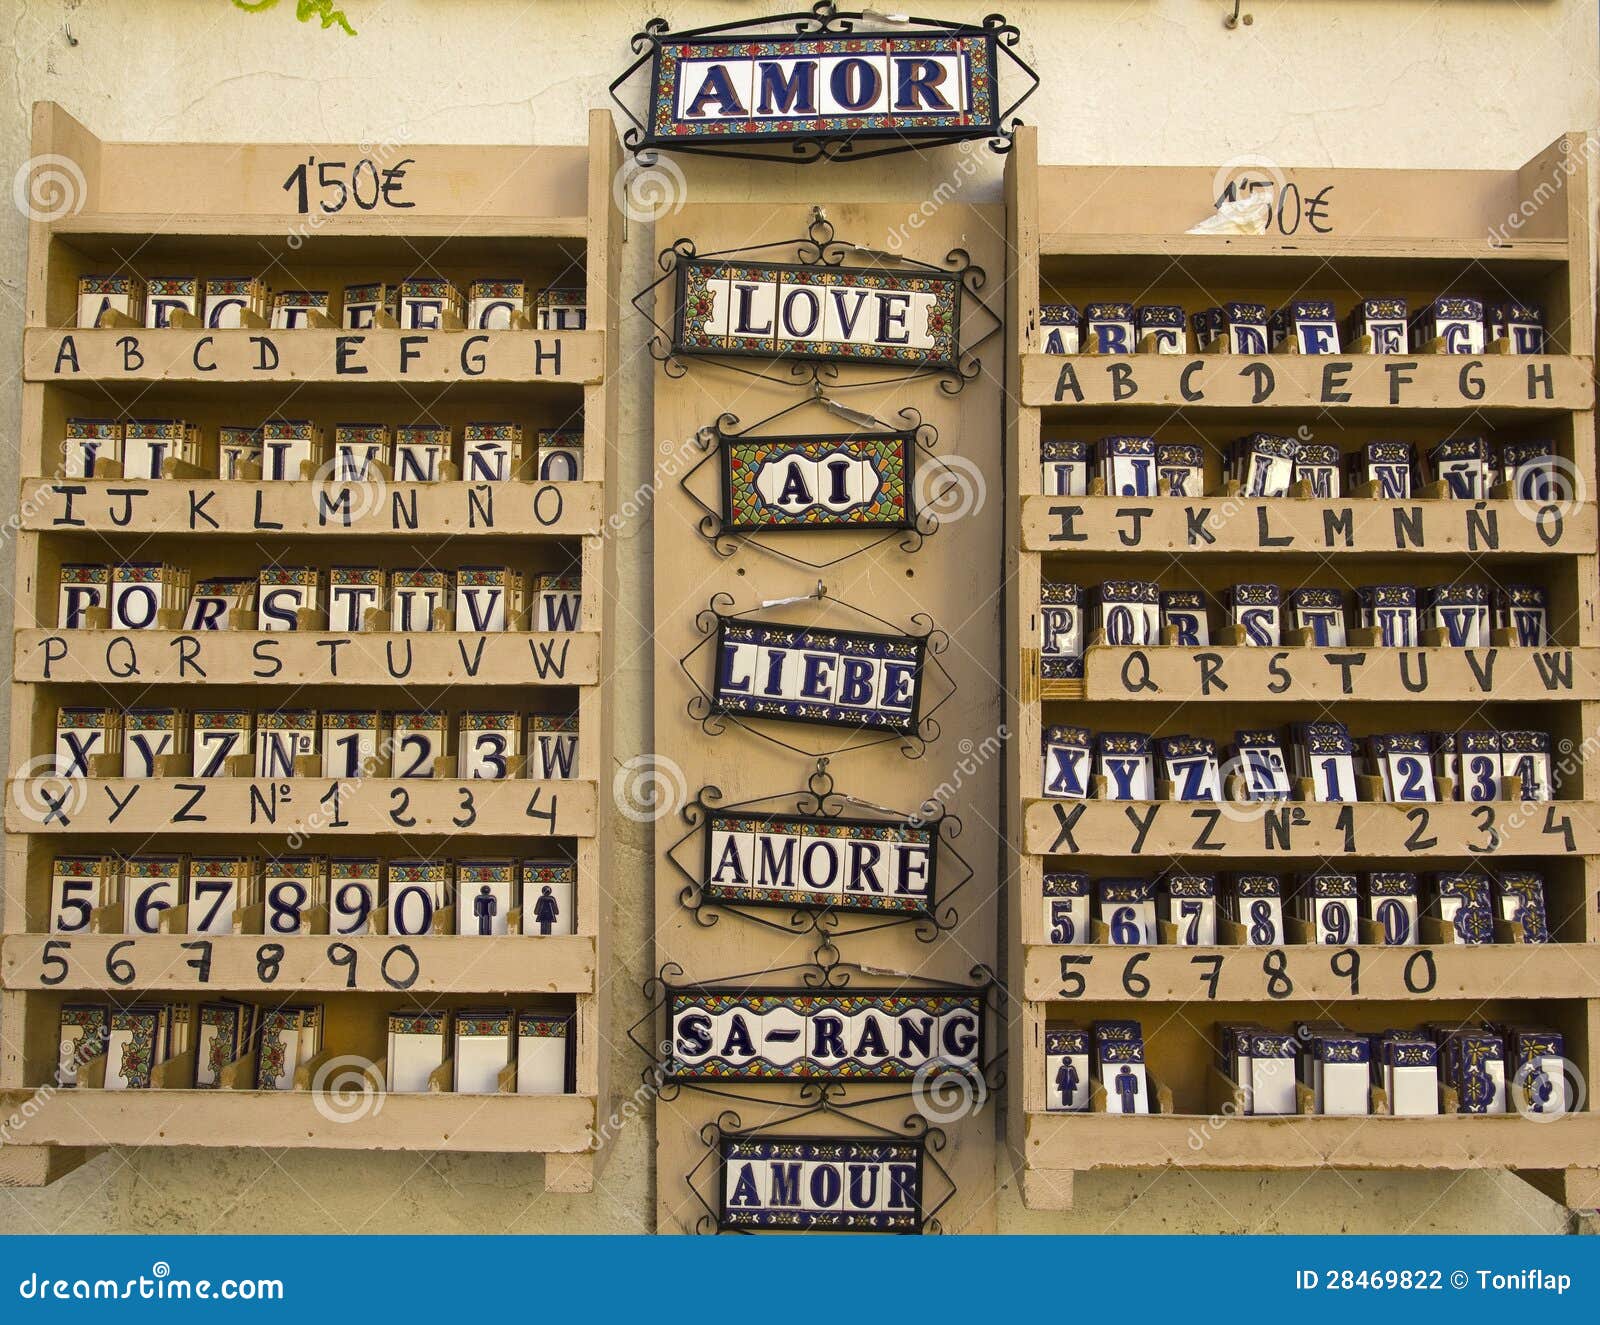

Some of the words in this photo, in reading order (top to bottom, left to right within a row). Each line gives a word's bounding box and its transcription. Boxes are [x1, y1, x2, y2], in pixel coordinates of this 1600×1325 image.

[686, 57, 956, 118] AMOR
[283, 156, 415, 213] 1'50€
[735, 283, 911, 344] LOVE
[55, 336, 79, 373] A
[116, 336, 144, 370] B
[194, 337, 216, 371] C
[250, 337, 278, 369] D
[336, 337, 368, 374] E
[400, 336, 428, 373] F
[461, 336, 489, 375] G
[535, 339, 560, 375] H
[1055, 363, 1084, 401] A
[1107, 363, 1137, 401] B
[1180, 361, 1204, 401] C
[1239, 363, 1274, 403] D
[1321, 363, 1352, 402] E
[1385, 363, 1417, 404] F
[1459, 361, 1485, 399] G
[1528, 364, 1553, 399] H
[51, 485, 86, 525] I
[107, 489, 149, 525] J
[189, 491, 219, 529] K
[254, 490, 283, 529] L
[319, 488, 351, 527] M
[393, 489, 418, 529] N
[468, 484, 493, 528] Ñ
[534, 485, 562, 526] O
[778, 461, 850, 505] AI
[1048, 506, 1088, 541] I
[1116, 508, 1153, 546] J
[1185, 507, 1216, 545] K
[1257, 506, 1294, 546] L
[1323, 508, 1353, 546] M
[1393, 507, 1424, 548] N
[1466, 502, 1498, 550] Ñ
[1536, 505, 1563, 546] O
[64, 586, 100, 628] P
[192, 598, 227, 630] R
[263, 588, 302, 630] S
[335, 588, 376, 630] T
[398, 591, 438, 631] U
[462, 590, 501, 631] V
[544, 594, 581, 631] W
[1041, 607, 1073, 653] P
[1168, 613, 1200, 645] R
[1240, 608, 1274, 646] S
[1303, 611, 1336, 646] T
[1440, 608, 1476, 647] V
[1514, 610, 1543, 646] W
[39, 636, 67, 678] P
[106, 636, 140, 677] Q
[170, 636, 206, 677] R
[253, 640, 282, 677] S
[317, 640, 351, 676] T
[387, 639, 412, 678] U
[459, 636, 486, 676] V
[529, 639, 570, 679] W
[719, 644, 917, 709] LIEBE
[1121, 651, 1158, 692] Q
[1194, 653, 1229, 695] R
[1267, 653, 1292, 693] S
[1324, 653, 1366, 694] T
[1399, 652, 1428, 693] U
[1465, 649, 1497, 692] V
[1533, 651, 1572, 691] W
[61, 732, 100, 777] X
[130, 734, 171, 777] Y
[203, 733, 240, 777] Z
[337, 733, 358, 777] 1
[400, 734, 434, 777] 2
[474, 734, 507, 778] 3
[539, 736, 578, 778] W
[1048, 748, 1085, 794] X
[1105, 759, 1140, 800] Y
[1172, 760, 1214, 800] Z
[1321, 758, 1343, 801] 1
[1397, 756, 1427, 800] 2
[1471, 756, 1496, 801] 3
[41, 786, 71, 826] X
[105, 784, 140, 823] Y
[173, 784, 207, 822] Z
[320, 781, 348, 827] 1
[390, 787, 416, 827] 2
[453, 788, 476, 827] 3
[526, 787, 557, 834] 4
[1049, 803, 1087, 853] X
[1125, 804, 1160, 853] Y
[1191, 809, 1226, 850] Z
[1336, 806, 1356, 852] 1
[1404, 808, 1438, 852] 2
[1469, 806, 1500, 853] 3
[1543, 806, 1576, 851] 4
[712, 834, 929, 896] AMORE
[58, 881, 93, 931] 5
[135, 882, 171, 933] 6
[196, 881, 232, 931] 7
[269, 882, 307, 932] 8
[336, 883, 372, 934] 9
[1050, 900, 1075, 944] 5
[1111, 907, 1140, 944] 6
[1181, 900, 1203, 945] 7
[1251, 900, 1275, 945] 8
[1322, 902, 1350, 944] 9
[40, 940, 71, 985] 5
[106, 940, 136, 985] 6
[180, 941, 212, 982] 7
[256, 943, 285, 983] 8
[327, 942, 357, 987] 9
[381, 944, 419, 989] 0
[1059, 955, 1093, 998] 5
[1122, 952, 1150, 998] 6
[1191, 955, 1224, 999] 7
[1263, 949, 1293, 999] 8
[1331, 949, 1360, 995] 9
[1404, 950, 1437, 993] 0
[676, 1013, 978, 1059] SA-RANG
[729, 1160, 917, 1211] AMOUR
